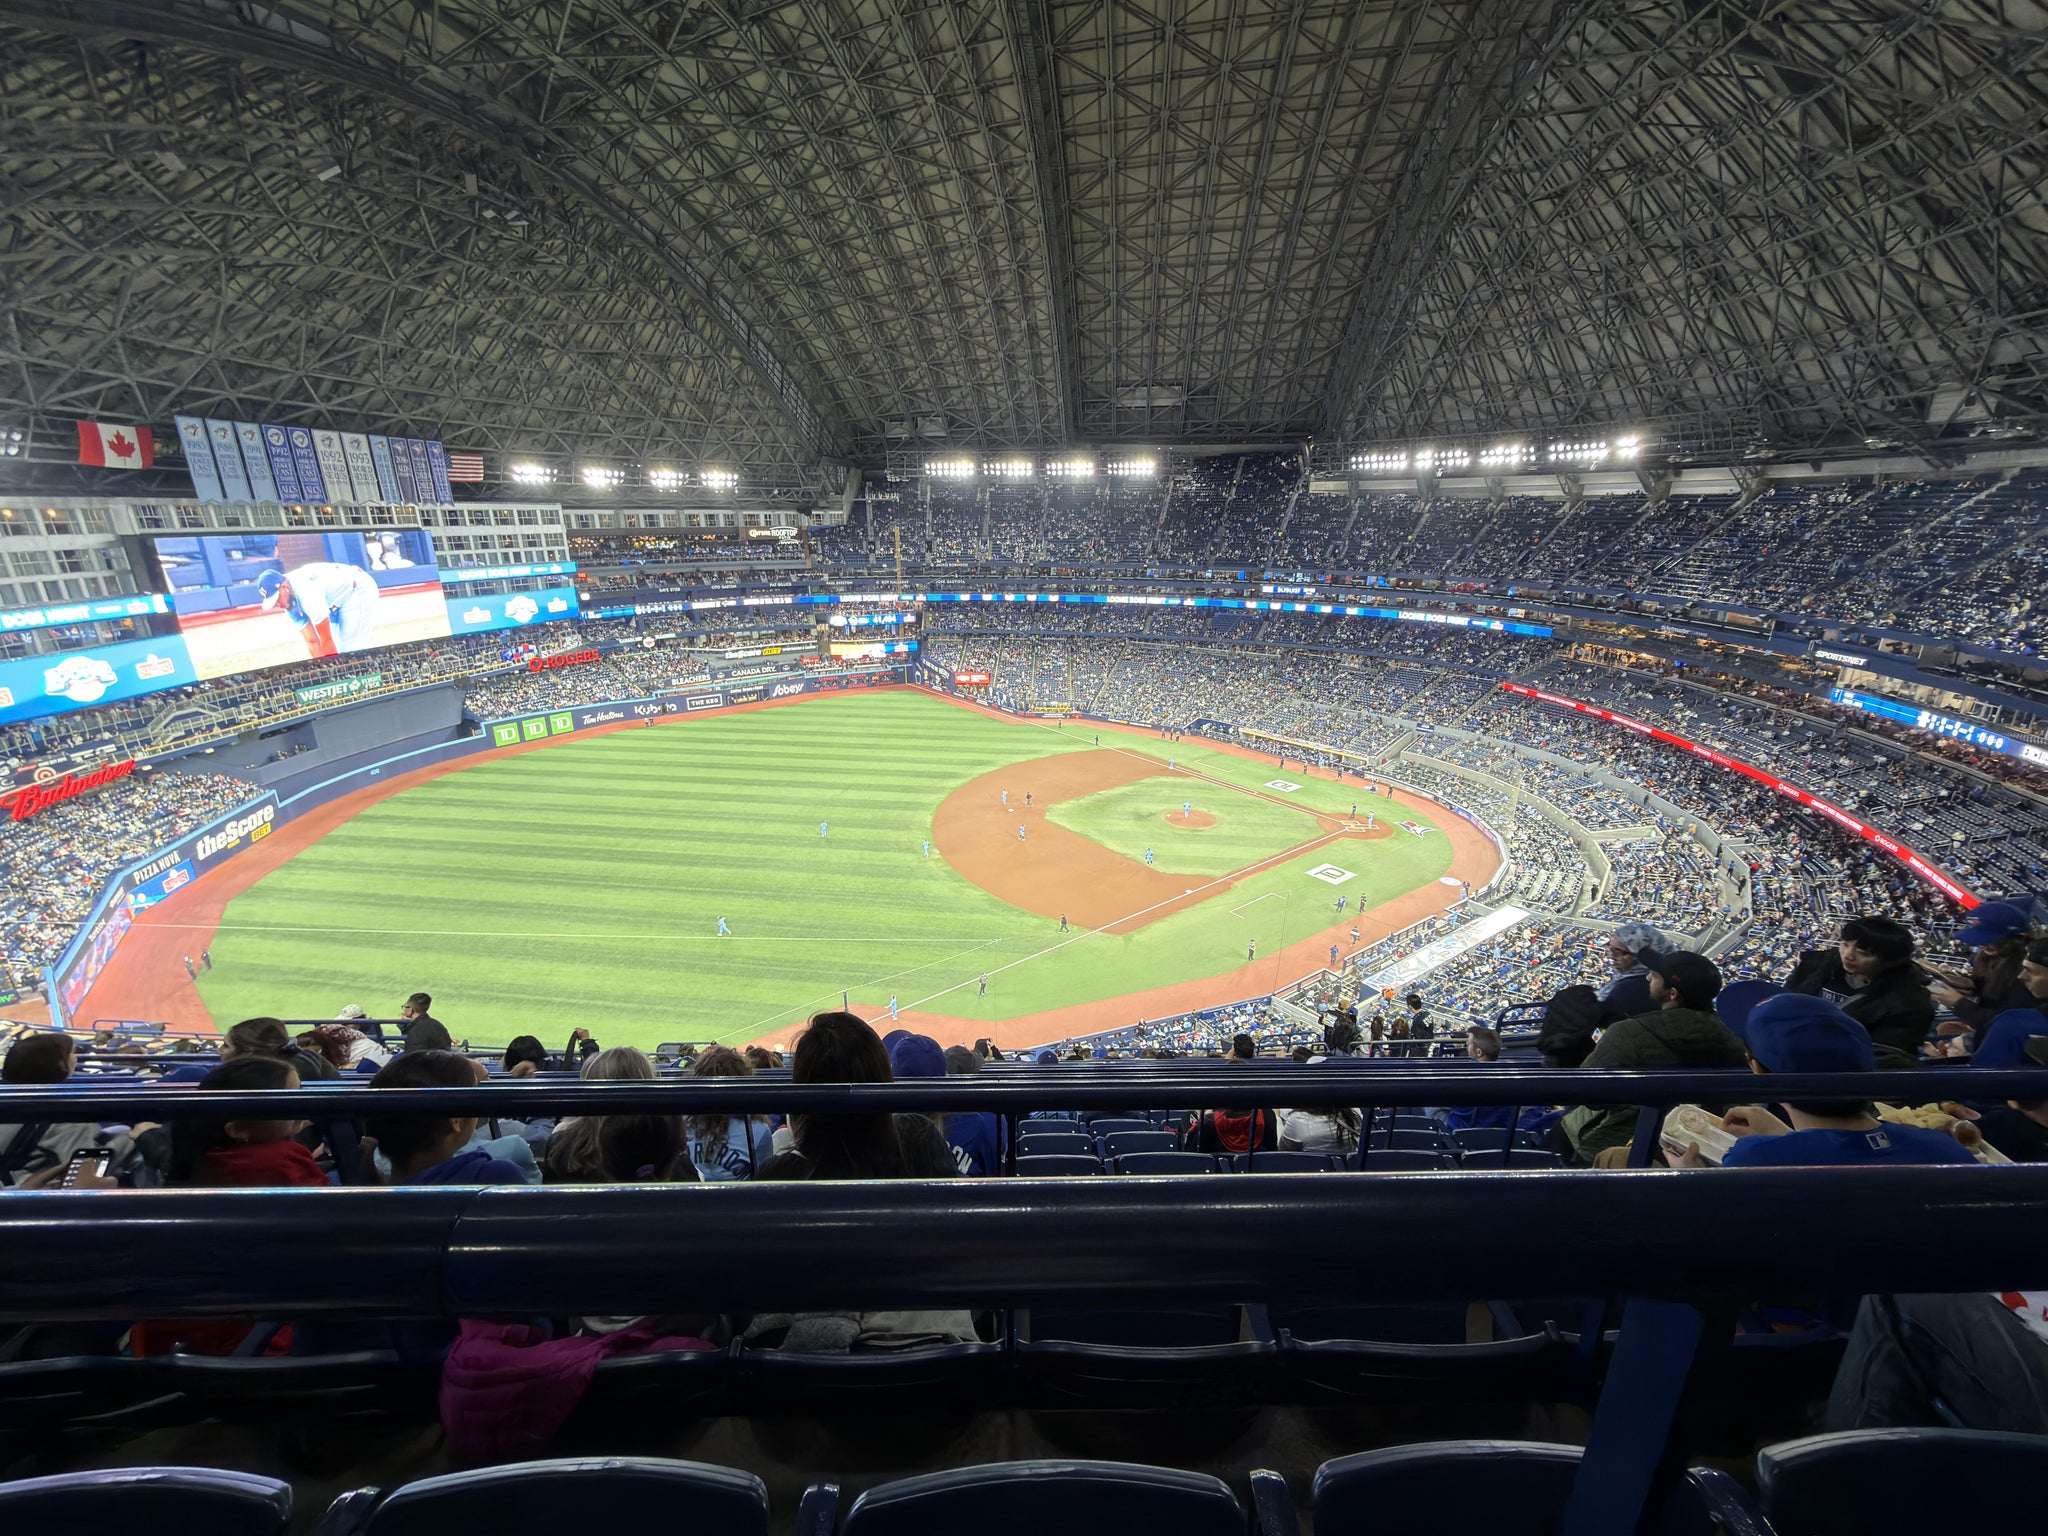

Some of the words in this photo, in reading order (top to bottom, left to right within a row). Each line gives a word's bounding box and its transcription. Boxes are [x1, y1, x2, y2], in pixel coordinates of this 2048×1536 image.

[271, 446, 288, 456] 1992
[320, 450, 343, 463] 1992
[771, 529, 798, 537] ROOFTOP
[546, 649, 600, 668] ROGERS
[1815, 650, 1869, 666] SPORTSNET
[672, 674, 711, 686] BLEACHERS
[731, 667, 761, 677] CANADA
[298, 682, 349, 702] WESTJET
[772, 683, 804, 698] Sobeys
[634, 701, 677, 716] Kubta
[706, 697, 719, 705] KEG
[551, 716, 571, 730] TD
[582, 713, 597, 725] Tim
[598, 710, 625, 722] Hortons
[496, 728, 517, 742] TD
[526, 722, 544, 736] TD
[1697, 746, 1711, 757] ROGERS
[1711, 753, 1732, 766] TERRACE
[0, 758, 136, 822] Budweiser
[1783, 785, 1800, 797] ROGERS
[196, 804, 275, 861] theScore
[252, 824, 270, 841] BET
[1880, 837, 1899, 853] ROGERS
[132, 864, 161, 885] PIZZA
[157, 852, 182, 875] NOVA
